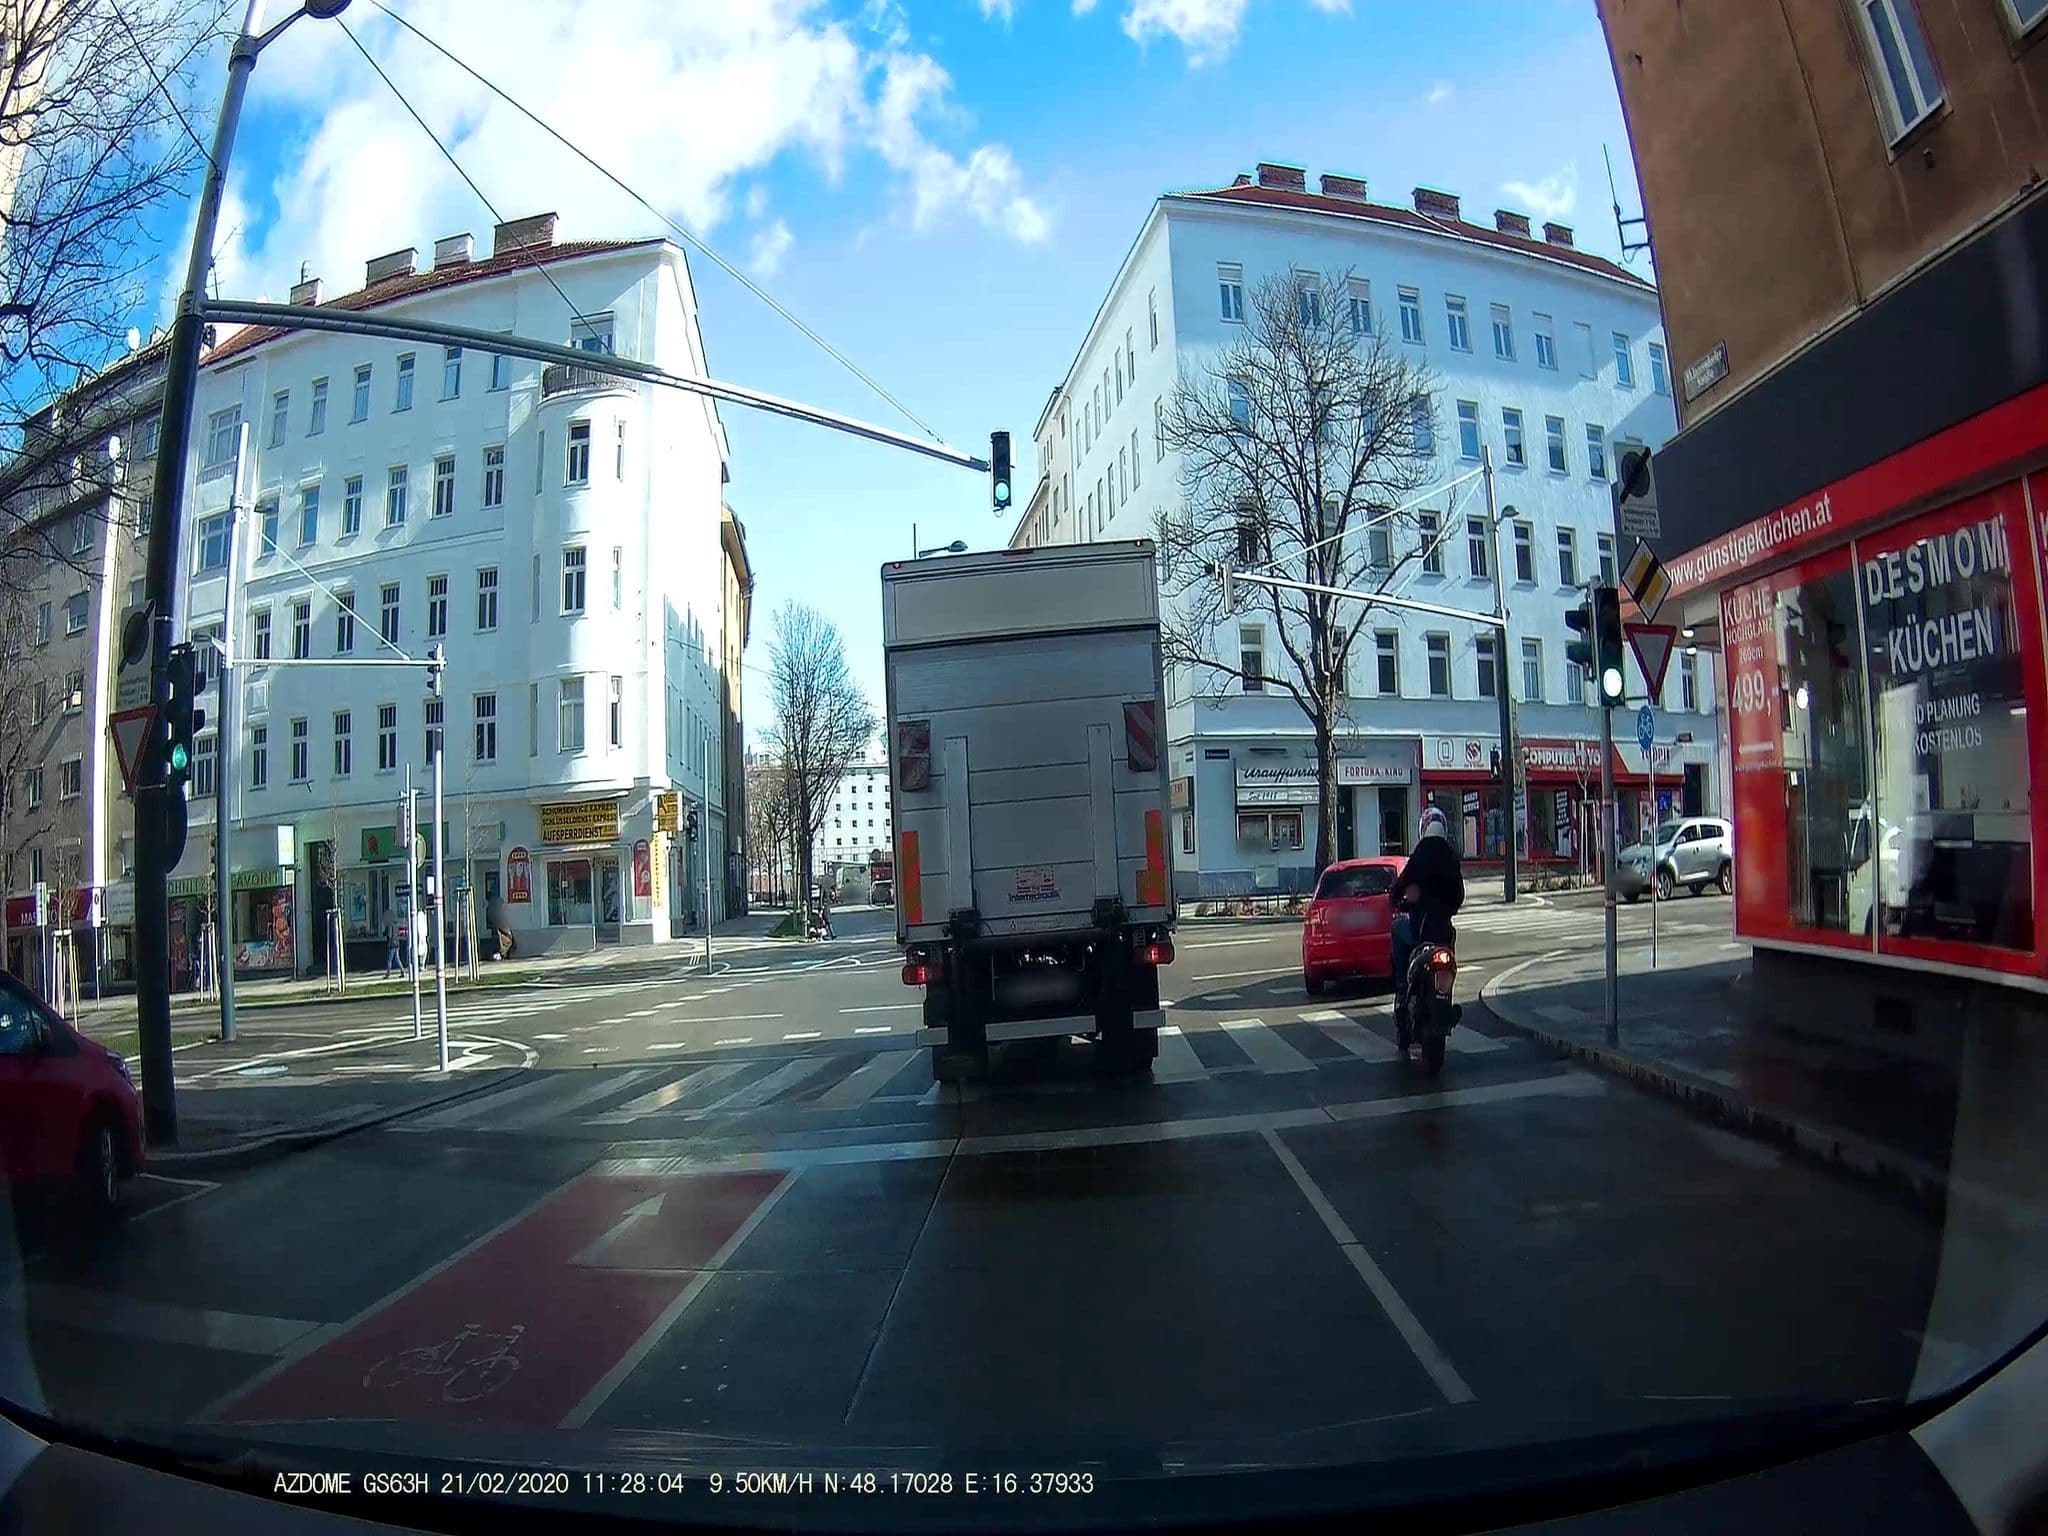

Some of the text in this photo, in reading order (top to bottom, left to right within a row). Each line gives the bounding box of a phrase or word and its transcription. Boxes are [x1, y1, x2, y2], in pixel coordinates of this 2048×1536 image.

[1888, 606, 1994, 676] KÜCHEN
[1926, 692, 1981, 724] PLANUNG
[1913, 725, 1983, 756] KOSTENLOS
[1345, 765, 1381, 778] FORTUNA
[542, 826, 603, 841] AUFSPERRDIENST
